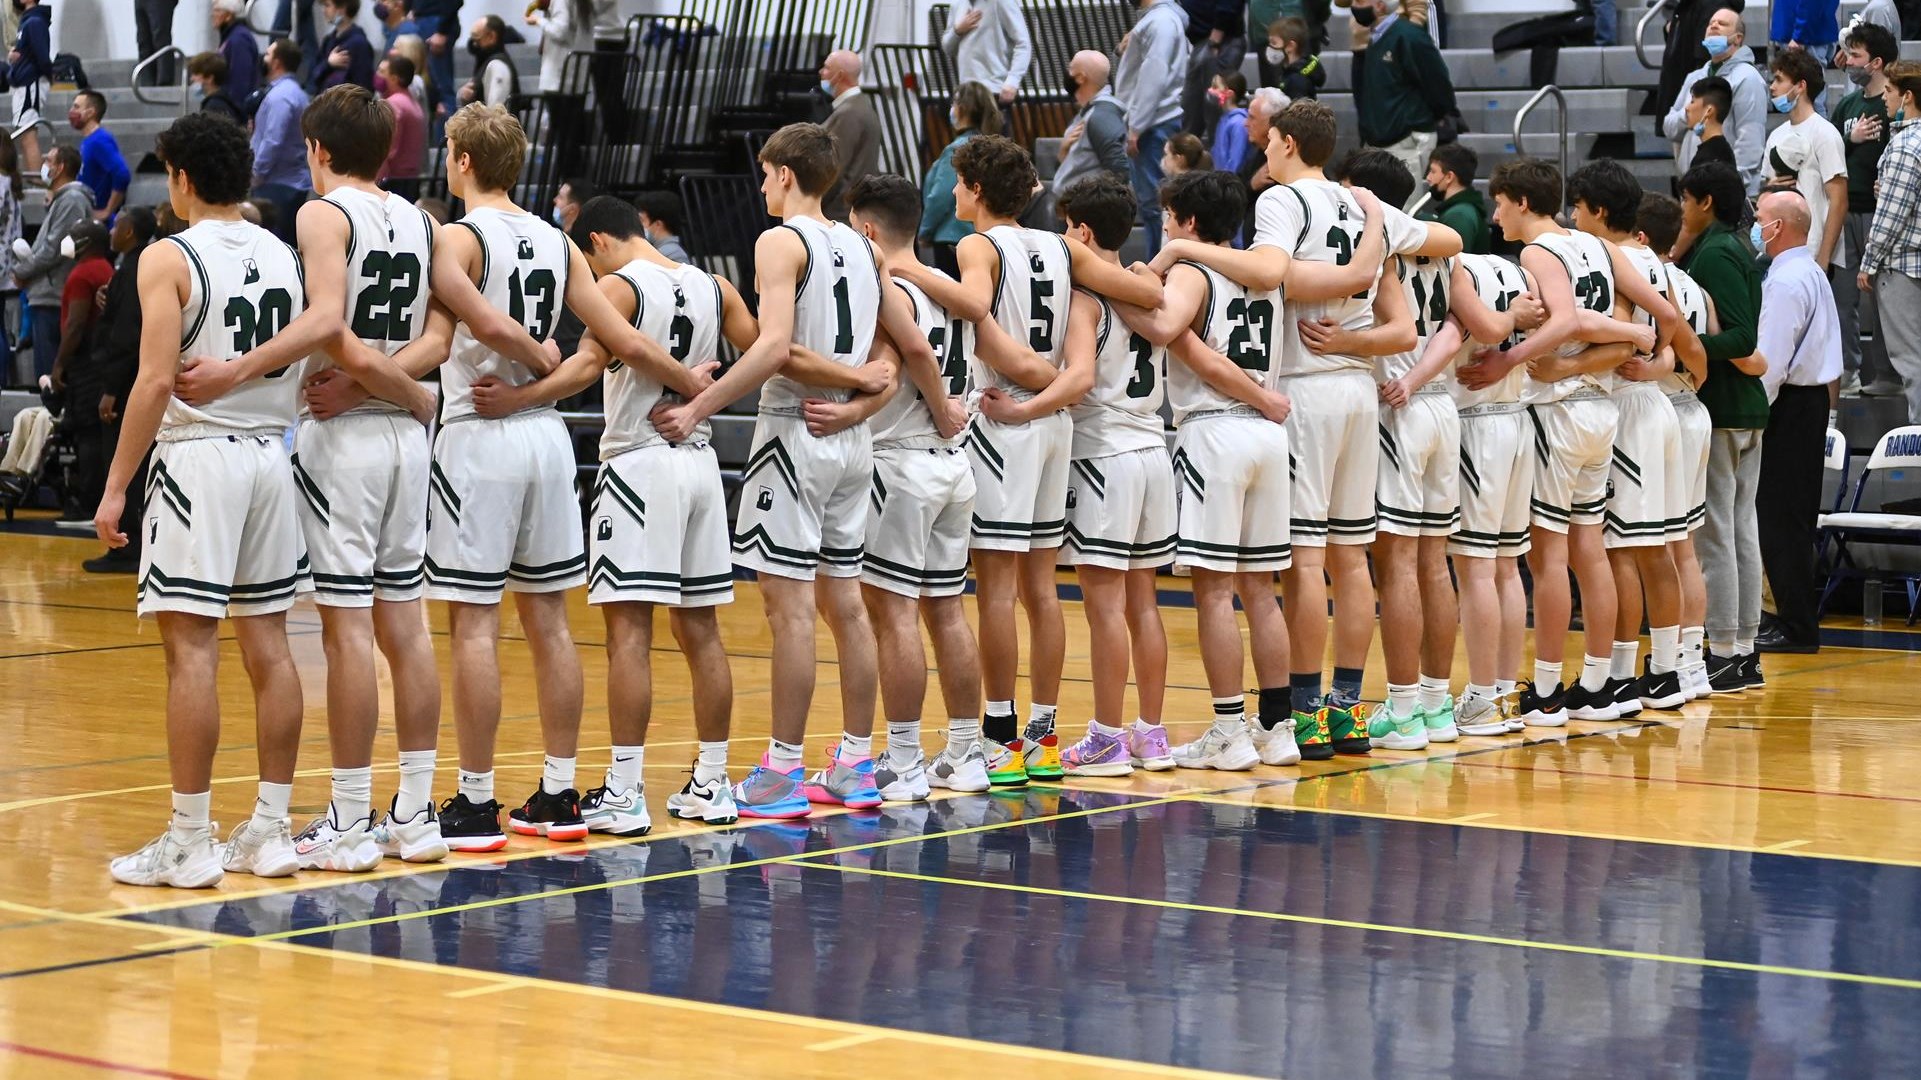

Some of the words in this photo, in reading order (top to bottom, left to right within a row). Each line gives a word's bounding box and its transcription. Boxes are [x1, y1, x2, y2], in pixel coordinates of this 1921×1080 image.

[223, 287, 292, 379] 30
[351, 250, 421, 340] 22
[508, 266, 556, 345] 13
[832, 275, 855, 354] 1
[1029, 276, 1054, 352] 5
[1411, 270, 1447, 337] 14
[1126, 330, 1155, 398] 3
[1226, 297, 1274, 371] 23
